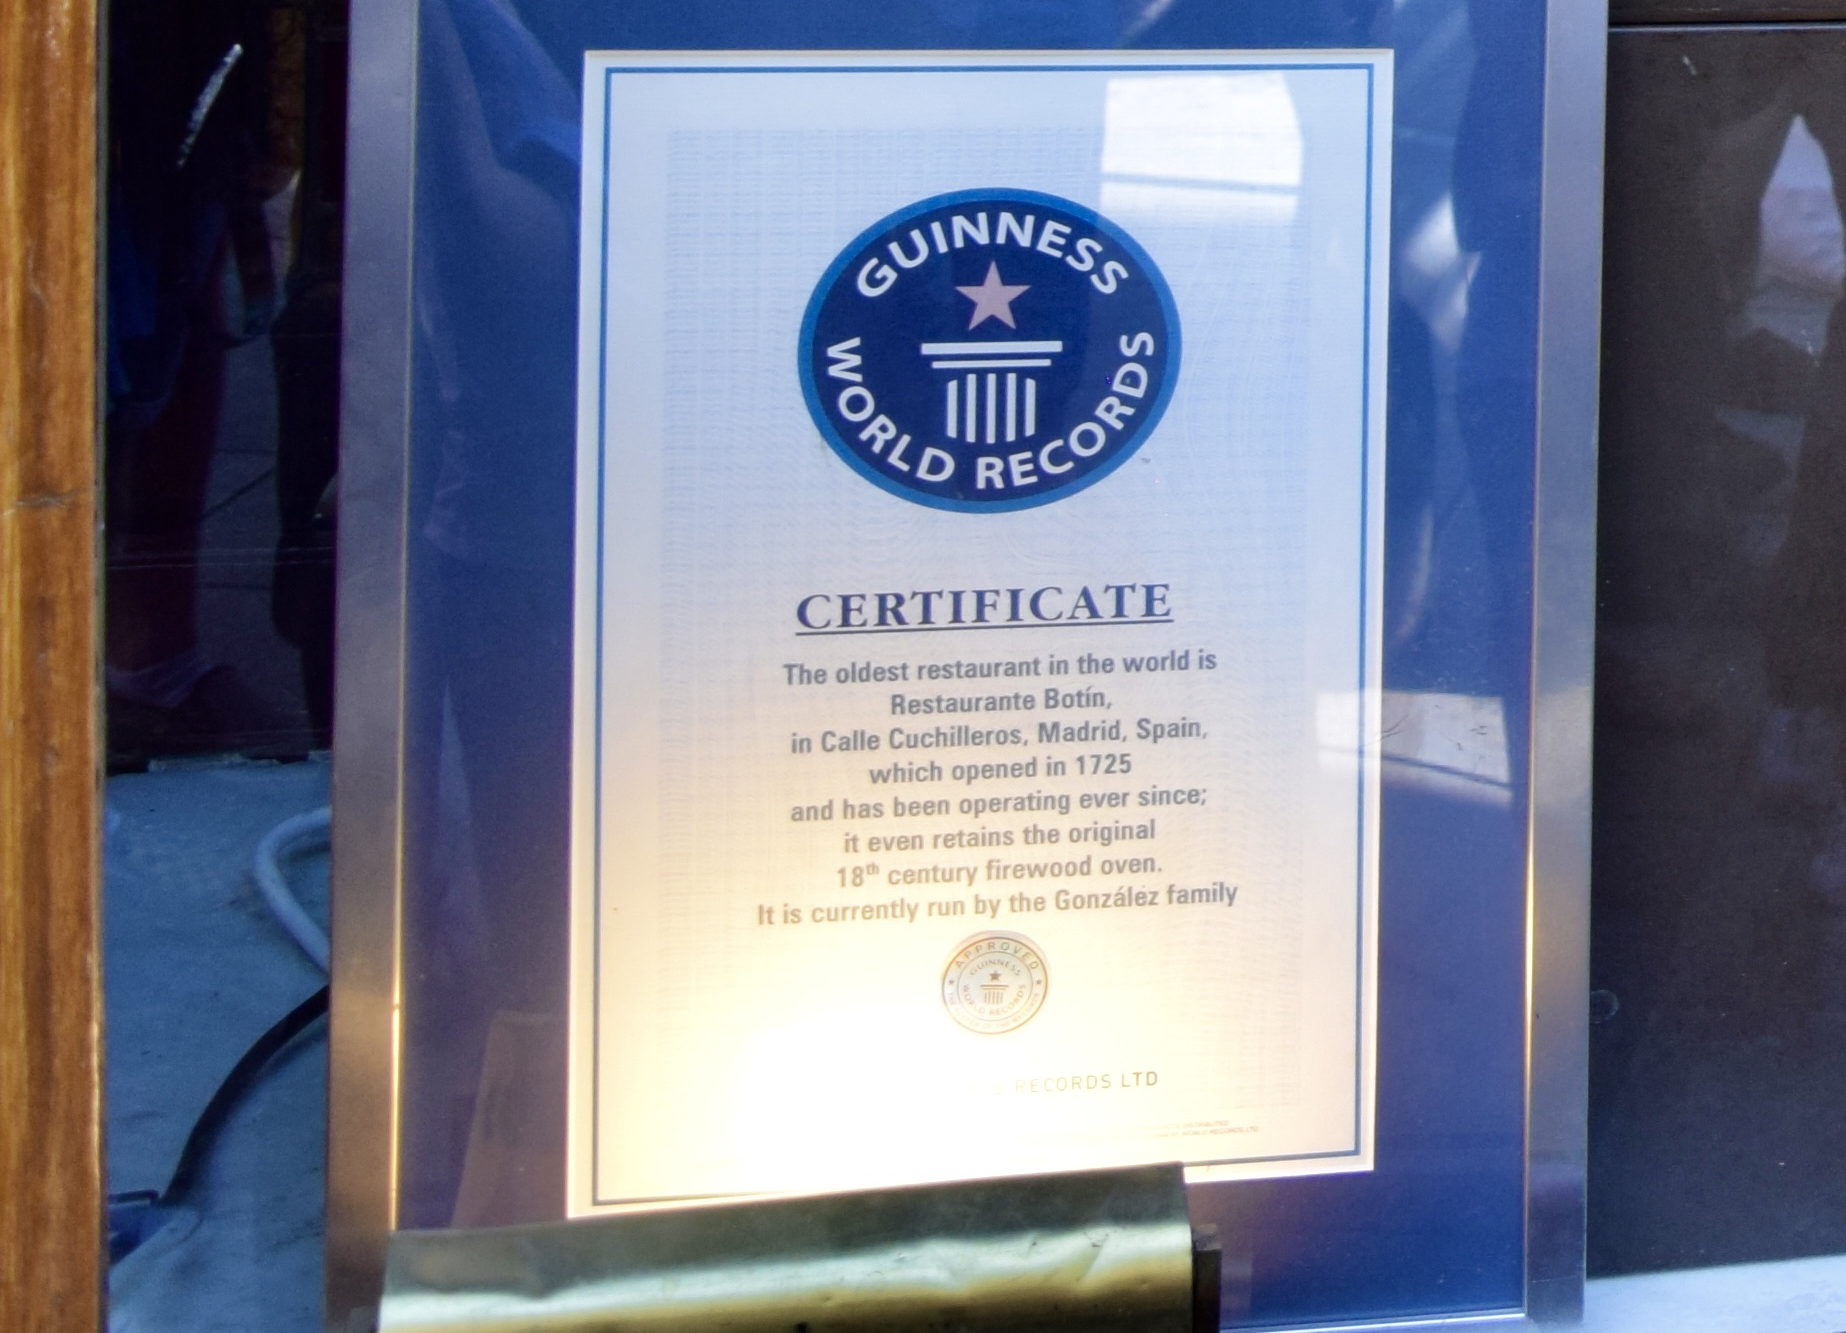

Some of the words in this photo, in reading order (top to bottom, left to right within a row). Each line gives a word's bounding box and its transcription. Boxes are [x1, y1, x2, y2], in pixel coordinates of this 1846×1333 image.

[856, 211, 1129, 298] GUINNESS
[827, 336, 956, 483] WORLD
[976, 331, 1155, 491] RECORDS
[796, 582, 1173, 630] CERTIFICATE
[783, 663, 828, 685] The
[836, 660, 909, 684] oldest
[917, 657, 1040, 681] restaurant
[1049, 654, 1069, 676] in
[1077, 652, 1115, 675] the
[1123, 649, 1190, 673] world
[1199, 649, 1217, 670] is
[890, 690, 1036, 715] Restaurante
[1045, 685, 1112, 710] Botín,
[791, 732, 812, 753] in
[821, 728, 881, 753] Calle
[889, 723, 1029, 750] Cuchilleros,
[1038, 719, 1126, 744] Madrid,
[1136, 716, 1208, 744] Spain,
[869, 760, 943, 785] which
[952, 758, 1038, 785] opened
[1046, 756, 1066, 777] in
[1076, 754, 1132, 776] 1725
[790, 800, 834, 821] and
[843, 797, 884, 819] has
[894, 794, 950, 817] been
[959, 790, 1071, 818] operating
[1079, 790, 1130, 810] ever
[1138, 785, 1207, 808] since;
[844, 832, 859, 853] it
[868, 833, 924, 852] even
[933, 826, 1015, 849] retains
[1023, 824, 1061, 845] the
[1068, 819, 1157, 846] original
[837, 861, 880, 888] 18th
[887, 862, 978, 889] century
[985, 856, 1092, 881] firewood
[1100, 854, 1164, 876] oven.
[758, 904, 775, 926] It
[783, 902, 802, 924] is
[811, 896, 919, 924] currently
[927, 898, 965, 918] run
[974, 893, 1001, 919] by
[1009, 891, 1046, 913] the
[1055, 885, 1160, 910] González
[1166, 880, 1239, 909] family
[955, 941, 1040, 970] APPROVED
[970, 958, 1022, 977] GUINNESS
[989, 983, 1026, 1016] RECORDS
[1014, 1073, 1113, 1094] RECORDS
[1121, 1070, 1160, 1088] LTD
